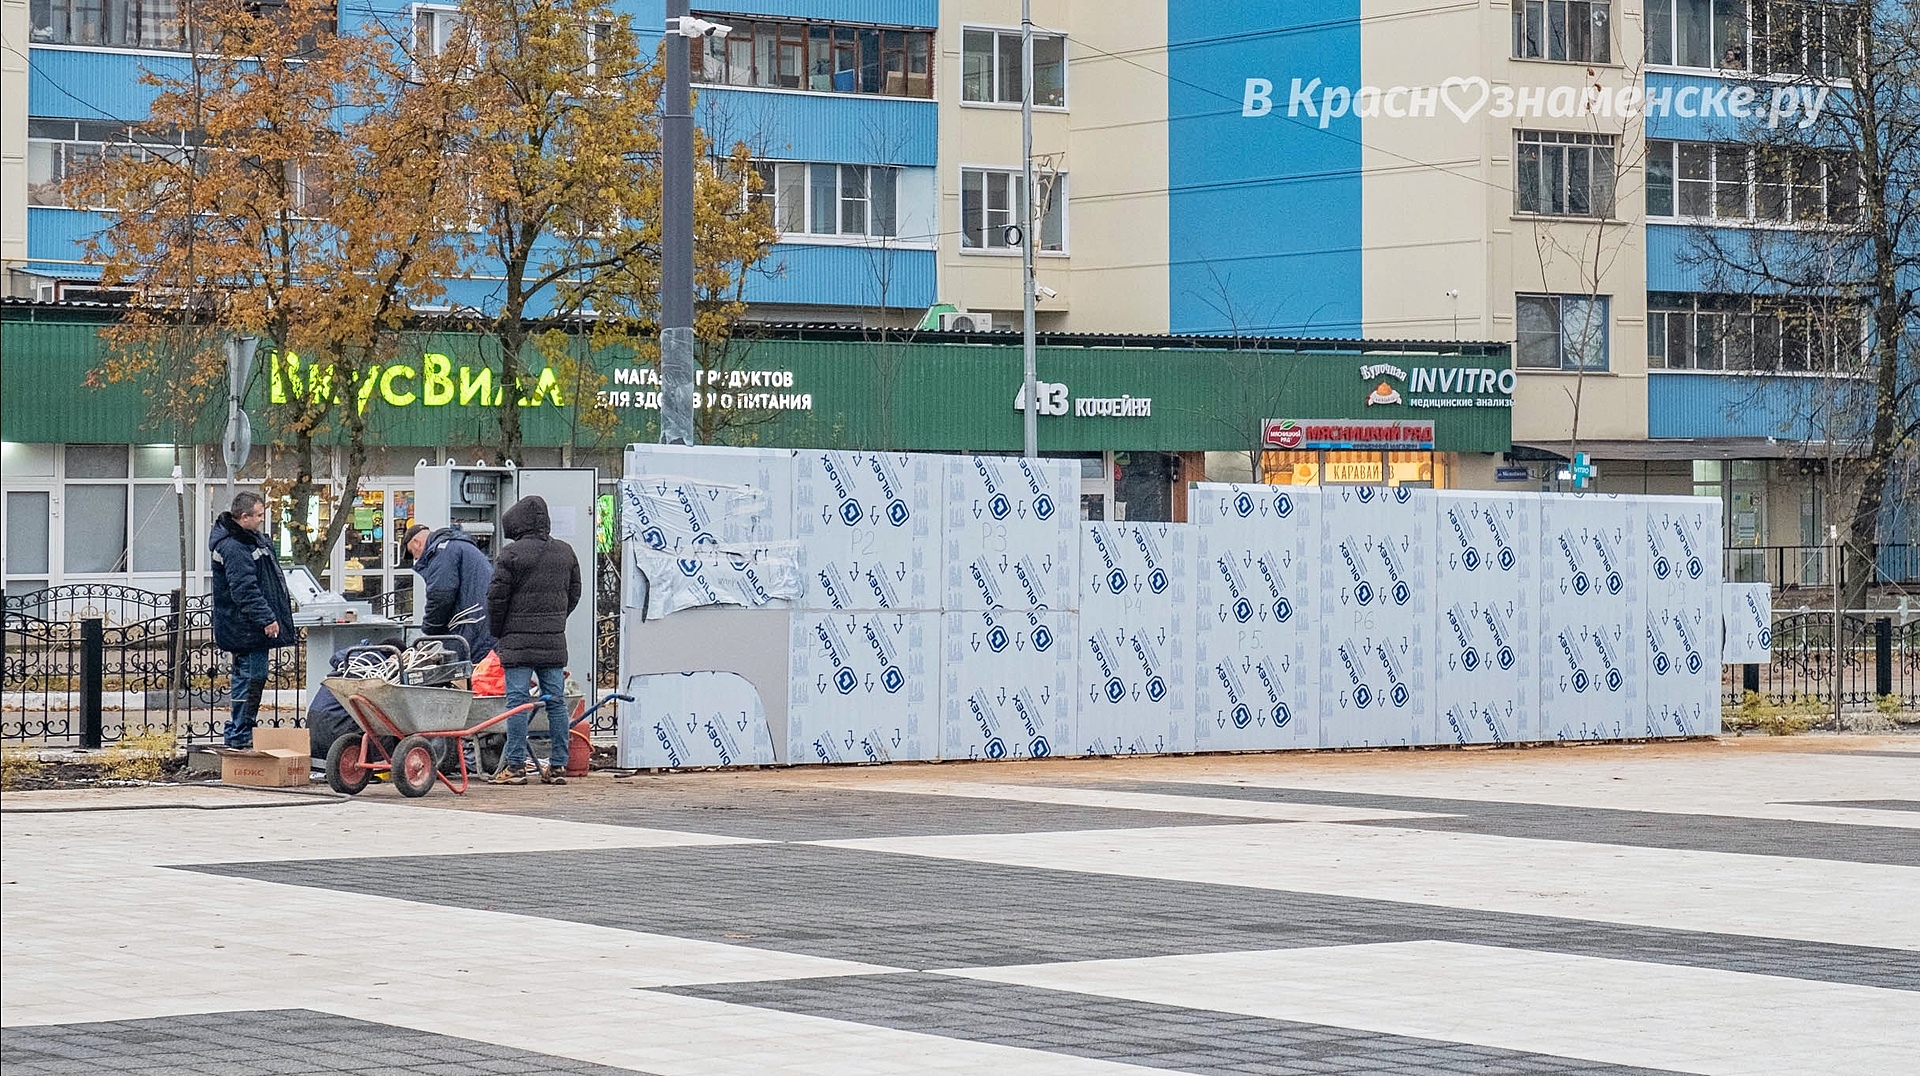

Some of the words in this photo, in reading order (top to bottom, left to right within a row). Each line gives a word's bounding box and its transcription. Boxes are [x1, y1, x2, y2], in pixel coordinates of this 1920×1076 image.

[1410, 367, 1518, 394] INVITRO
[1075, 395, 1151, 417] КОФЕЙНЯ
[1410, 399, 1473, 408] медицинские
[1305, 422, 1402, 441] МЯСНИЦКИЙ
[1403, 425, 1433, 442] РЯД
[820, 454, 847, 498] BILDEX
[869, 455, 893, 500] BILDEX
[675, 487, 700, 532] BILDEX
[1448, 509, 1467, 547] BILDEX
[1484, 509, 1503, 547] BILDEX
[1091, 527, 1113, 568] BILDEX
[1132, 527, 1154, 569] BILDEX
[1558, 535, 1577, 571] BILDEX
[1593, 535, 1611, 572] BILDEX
[1647, 531, 1658, 557] BILD
[1674, 520, 1690, 557] BILDEX
[1217, 558, 1239, 598] BILDEX
[1257, 558, 1278, 598] BILDEX
[1339, 542, 1360, 581] BILDEX
[1378, 542, 1397, 580] BILDEX
[969, 563, 993, 606] BILDEX
[1014, 563, 1038, 606] BILDEX
[1447, 610, 1466, 647] BILDEX
[1483, 609, 1502, 646] BILDEX
[1745, 592, 1762, 628] BILDEX
[816, 623, 841, 667] BILDEX
[863, 623, 888, 667] BILDEX
[1558, 632, 1576, 669] BILDEX
[1593, 632, 1611, 669] BILDEX
[1647, 626, 1658, 652] BILD
[1673, 616, 1690, 652] BILDEX
[1089, 636, 1110, 677] BILDEX
[1131, 636, 1152, 677] BILDEX
[1338, 645, 1359, 685] BILDEX
[1376, 644, 1396, 683] BILDEX
[1216, 664, 1238, 704] BILDEX
[1256, 663, 1277, 703] BILDEX
[967, 697, 992, 737] BILDEX
[1012, 695, 1035, 737] BILDEX
[653, 723, 681, 767] BILDEX
[704, 721, 730, 766] BILDEX
